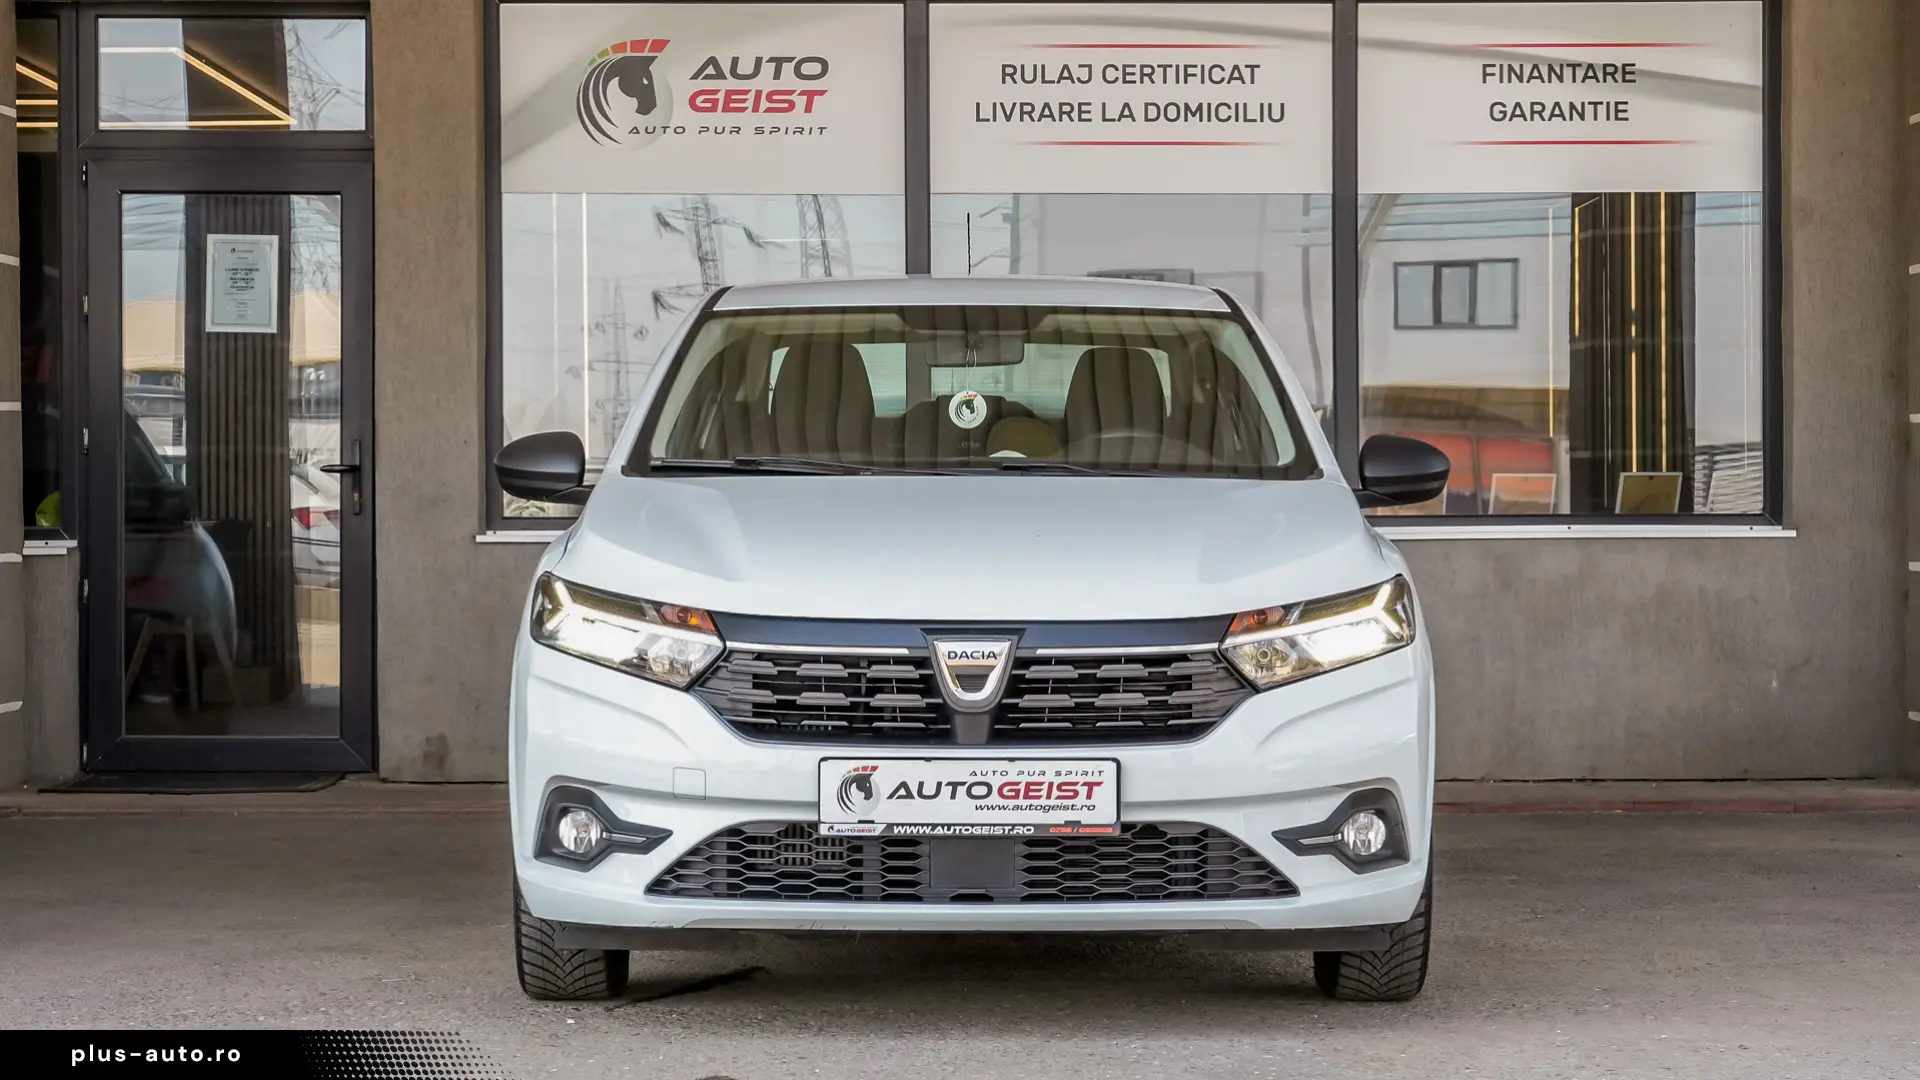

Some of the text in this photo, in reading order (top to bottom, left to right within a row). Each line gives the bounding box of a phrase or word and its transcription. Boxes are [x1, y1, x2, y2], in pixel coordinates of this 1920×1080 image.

[688, 55, 830, 81] AUTO
[1001, 63, 1261, 85] RULAJ CERTIFICAT
[1482, 62, 1637, 84] FINANTARE
[688, 88, 829, 114] GEIST
[975, 101, 1285, 123] LIVRARE LA DOMICILIU
[1489, 100, 1630, 122] GARANTIE
[627, 125, 828, 136] AUTO PUR SPIRIT
[947, 650, 998, 660] DACIA
[885, 780, 1105, 801] AUTOGEIST
[974, 802, 1096, 814] www.autogeist.ro
[893, 825, 1035, 835] WWW.AUTOGEIST.RO
